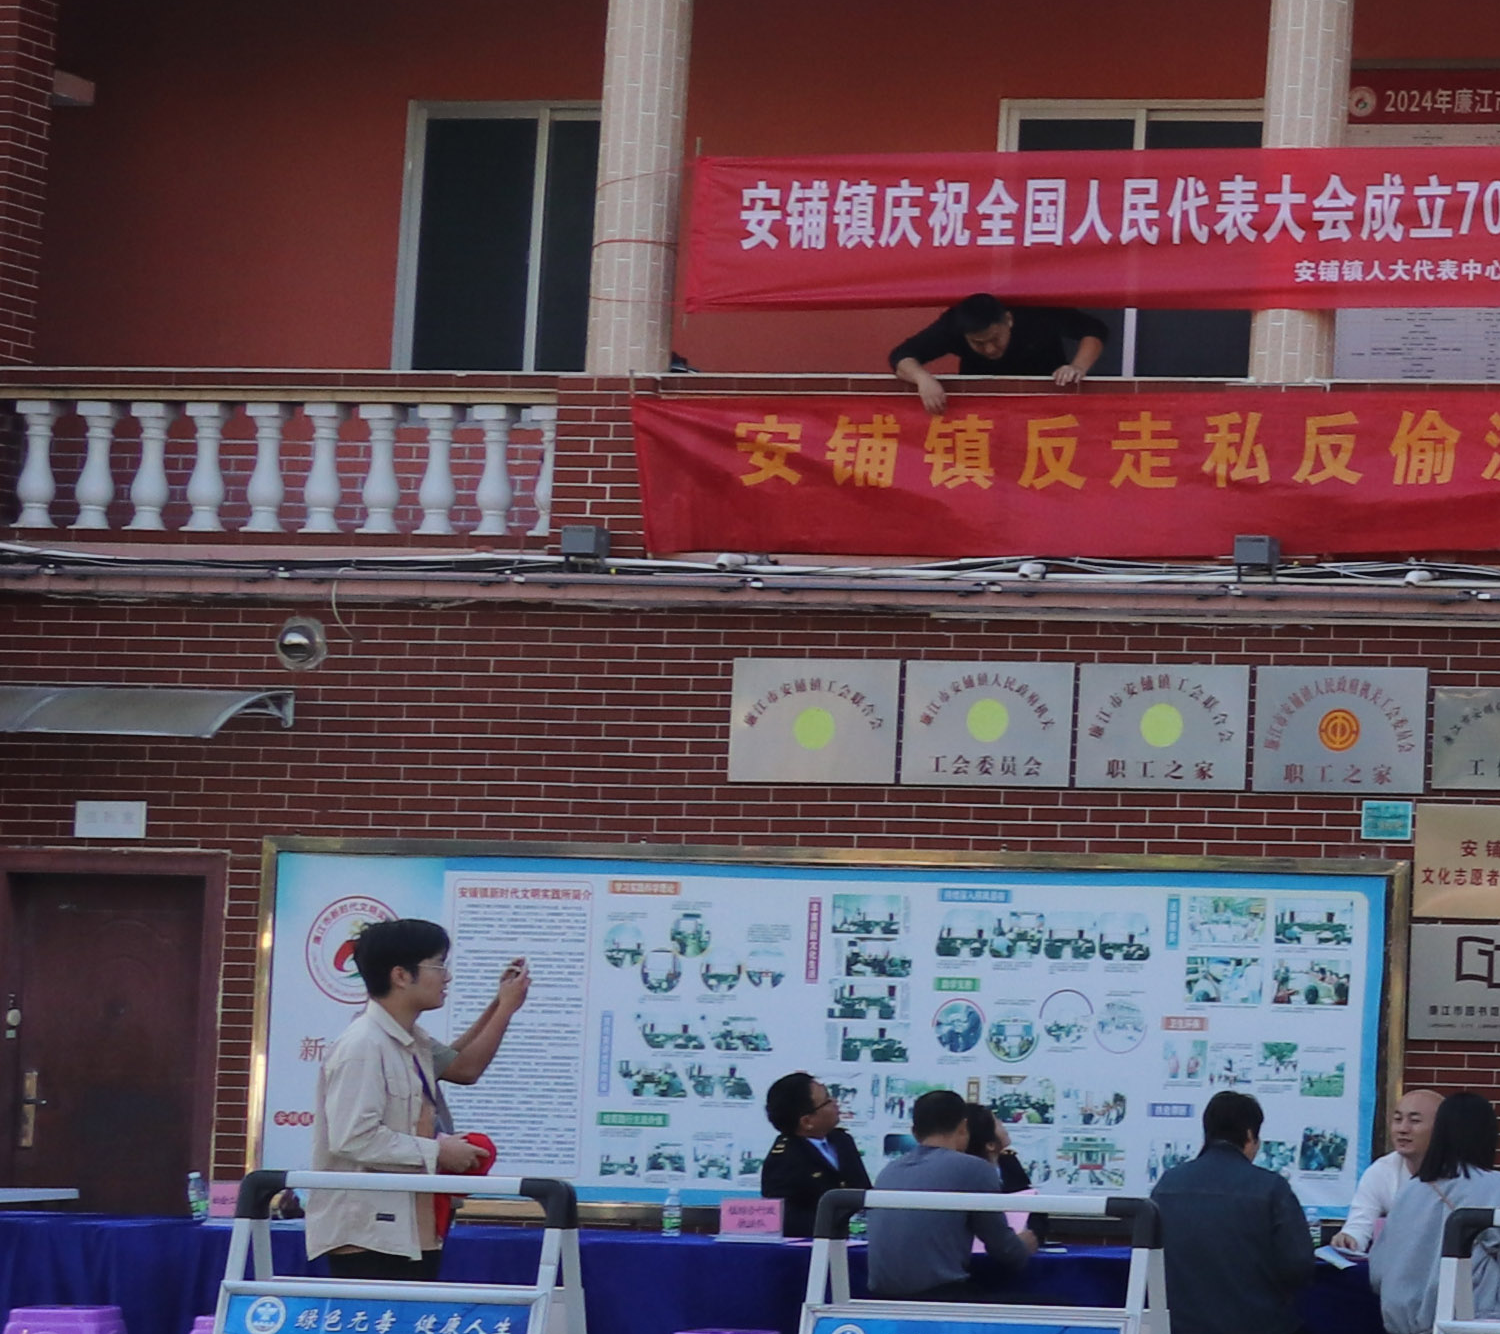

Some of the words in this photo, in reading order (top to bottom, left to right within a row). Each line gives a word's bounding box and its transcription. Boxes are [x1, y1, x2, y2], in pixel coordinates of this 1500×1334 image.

[929, 755, 1043, 778] 工会委员会
[1105, 759, 1215, 781] 职工之家
[1283, 763, 1393, 785] 职工之家
[295, 1309, 396, 1334] 绿色无毒
